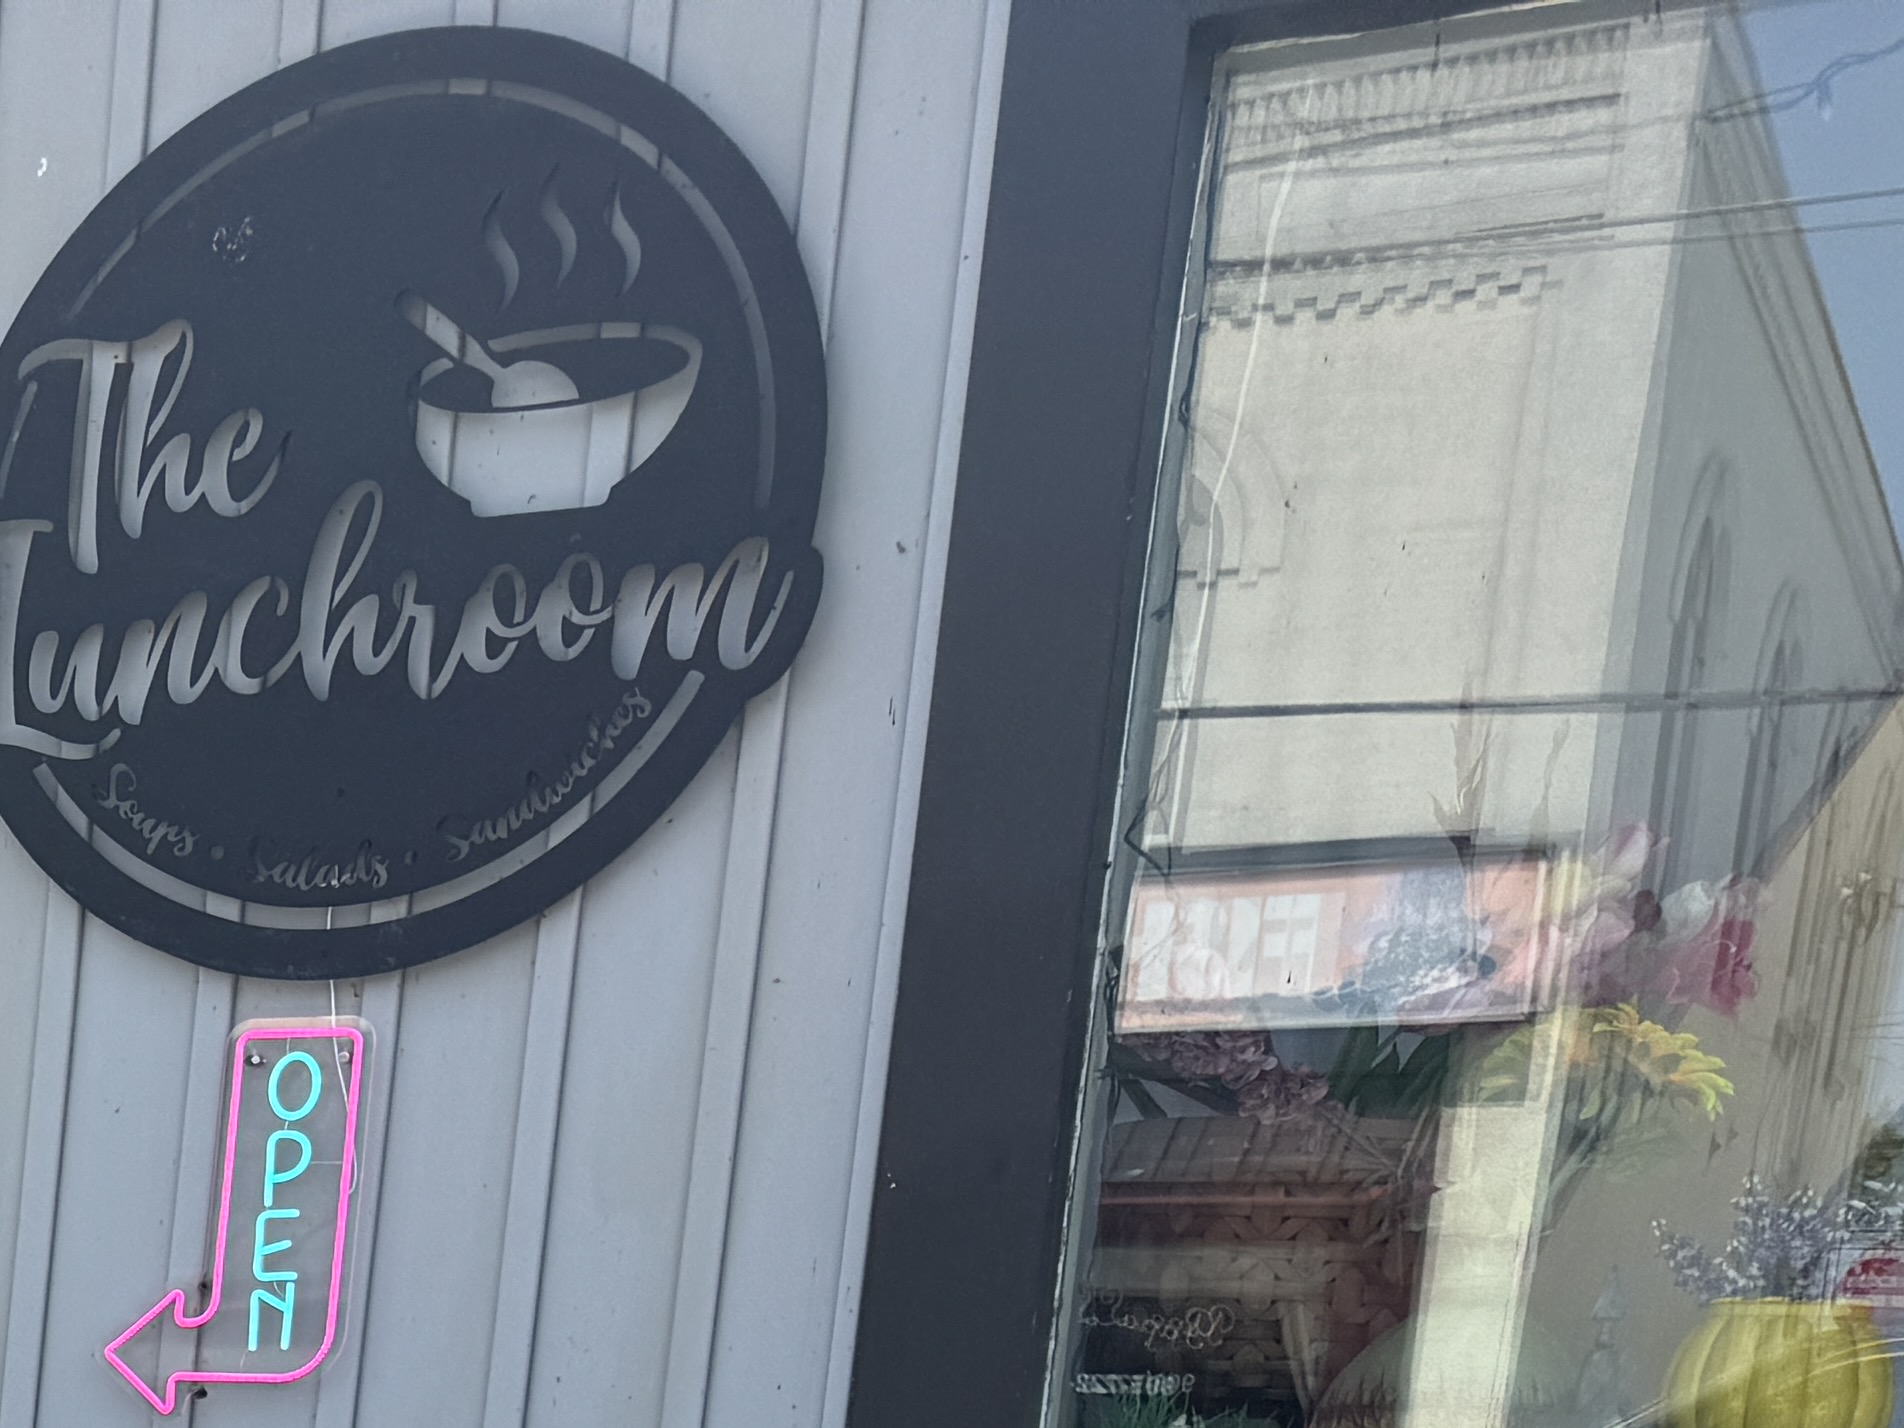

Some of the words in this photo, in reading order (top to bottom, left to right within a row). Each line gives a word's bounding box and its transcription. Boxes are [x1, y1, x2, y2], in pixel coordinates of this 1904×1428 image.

[17, 318, 292, 574] The
[95, 762, 201, 858] Soups
[248, 1051, 322, 1352] OPEN
